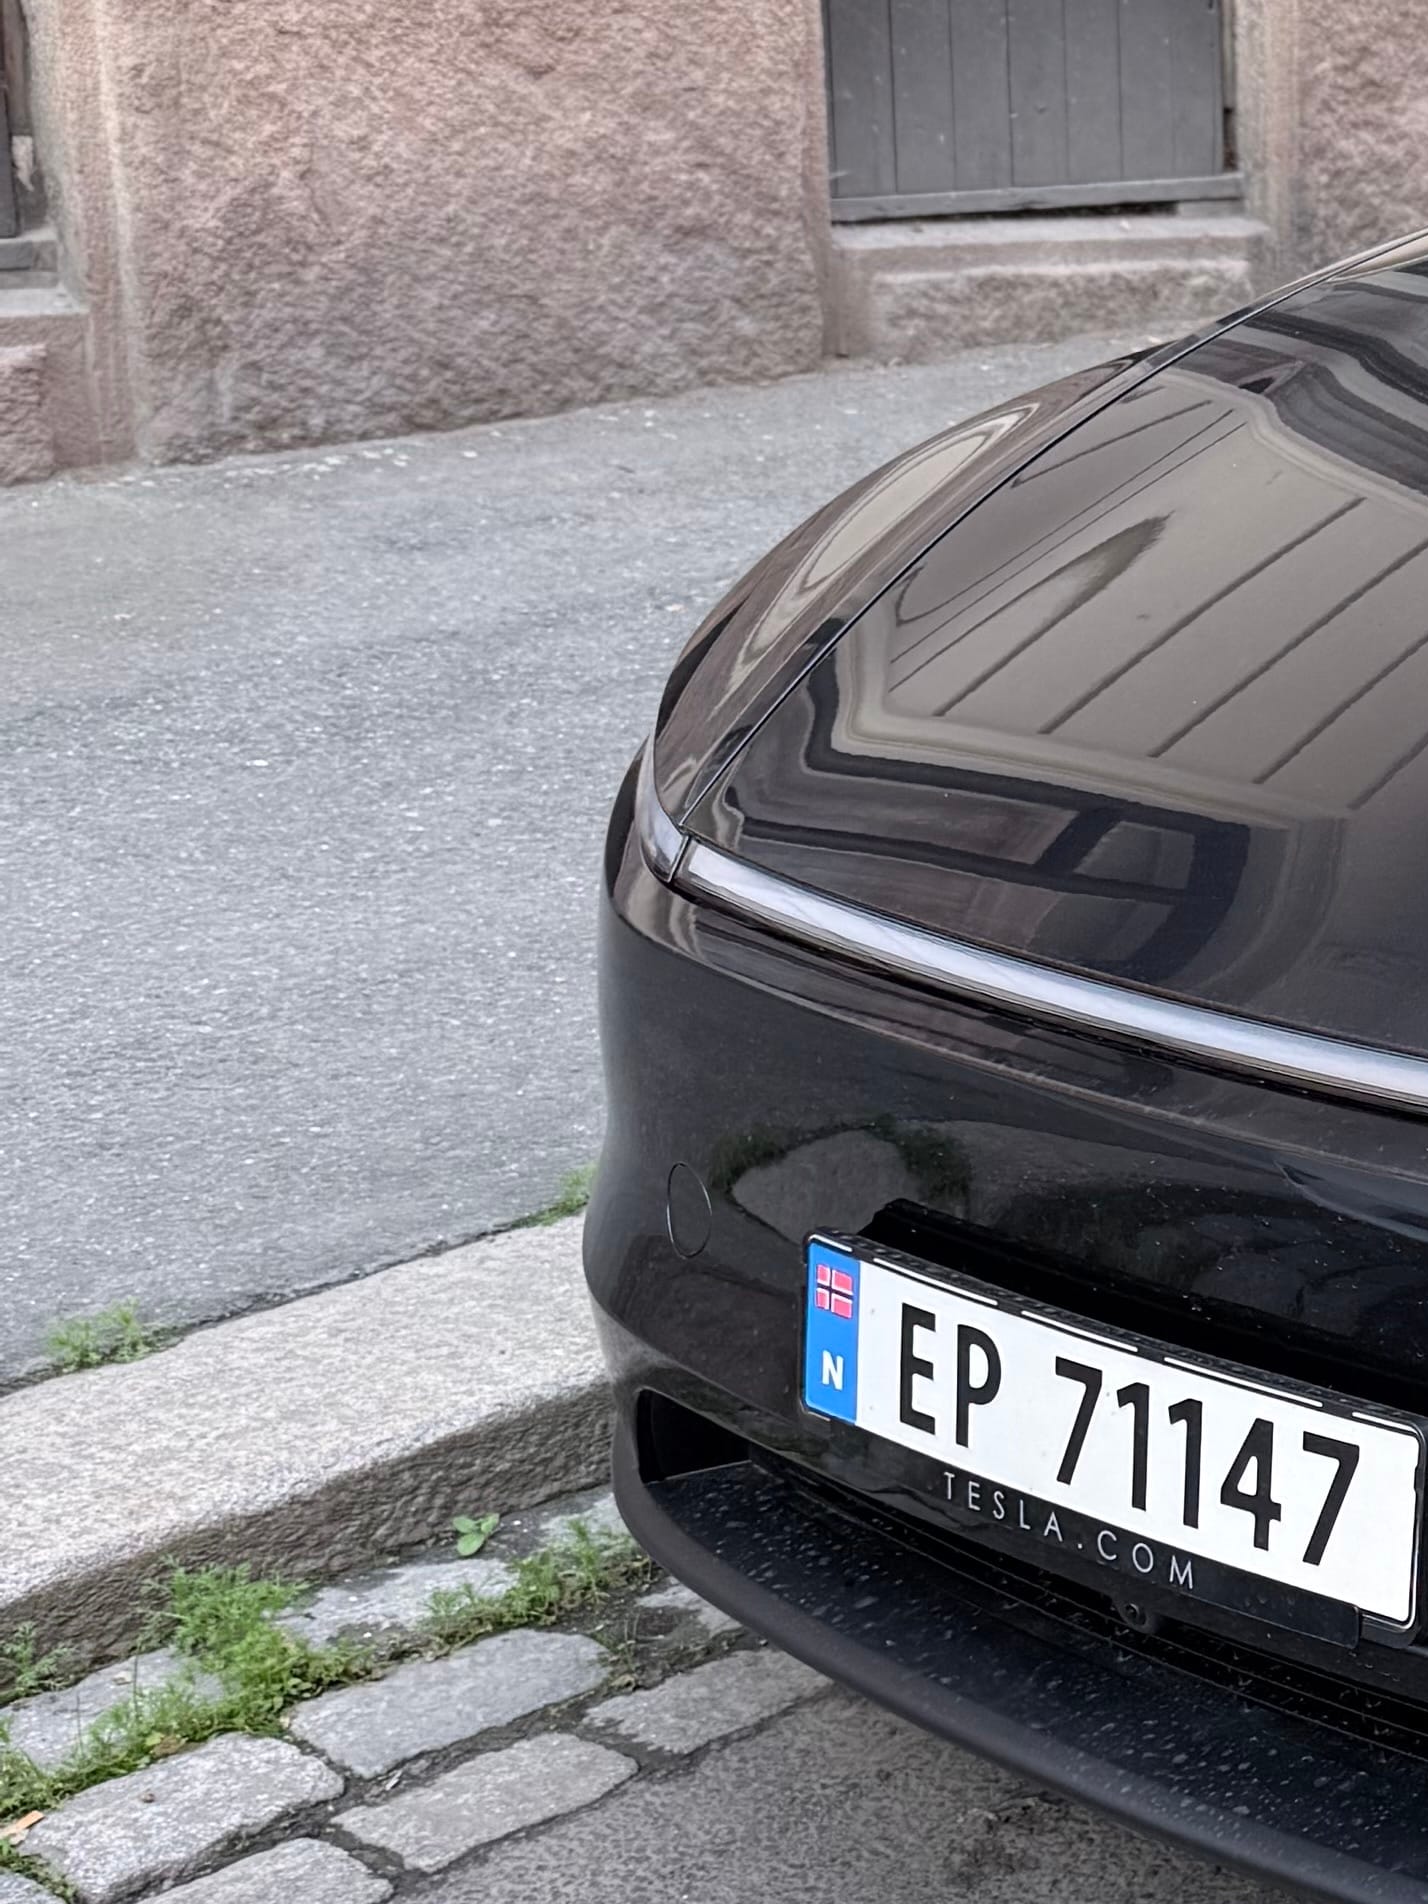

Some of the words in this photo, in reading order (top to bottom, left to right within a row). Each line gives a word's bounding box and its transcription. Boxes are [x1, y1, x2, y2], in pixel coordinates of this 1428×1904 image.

[821, 1349, 844, 1391] N
[900, 1302, 1002, 1448] EP
[1055, 1355, 1360, 1567] 71147
[943, 1471, 1194, 1590] TESLA.COM
